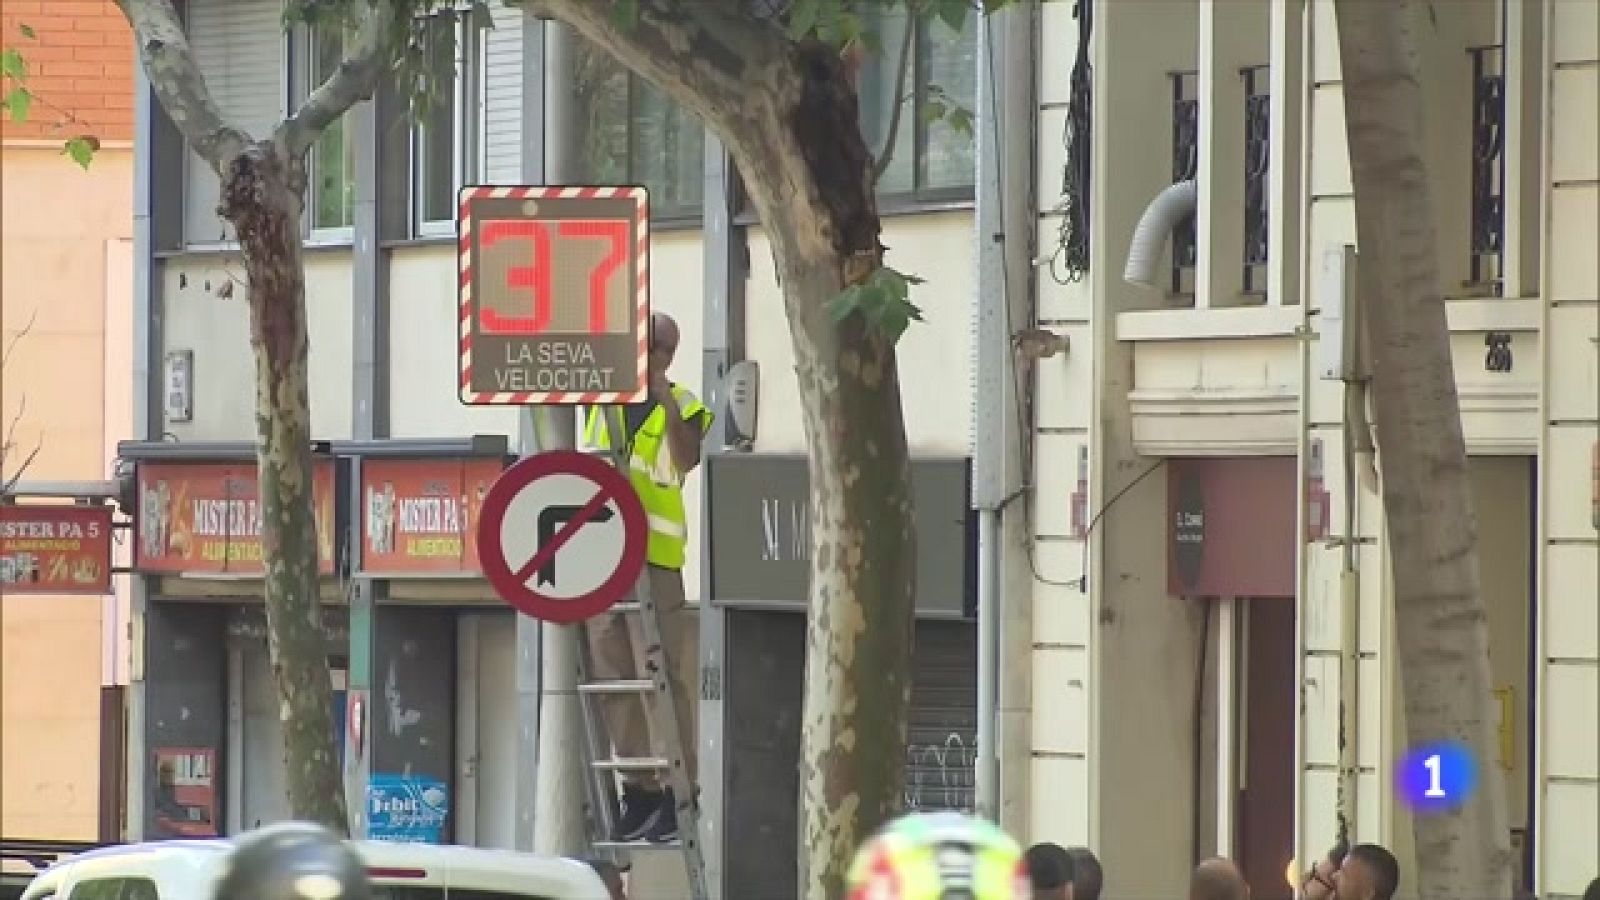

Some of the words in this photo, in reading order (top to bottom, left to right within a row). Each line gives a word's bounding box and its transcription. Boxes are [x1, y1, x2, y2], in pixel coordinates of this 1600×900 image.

[480, 221, 630, 335] 37
[506, 342, 533, 364] LA
[536, 342, 595, 364] SEVA
[495, 367, 614, 390] VELOCITAT
[193, 500, 246, 535] MISTER
[400, 498, 441, 532] MISTER
[444, 498, 459, 532] PA
[59, 522, 84, 538] PA
[87, 522, 100, 538] 5
